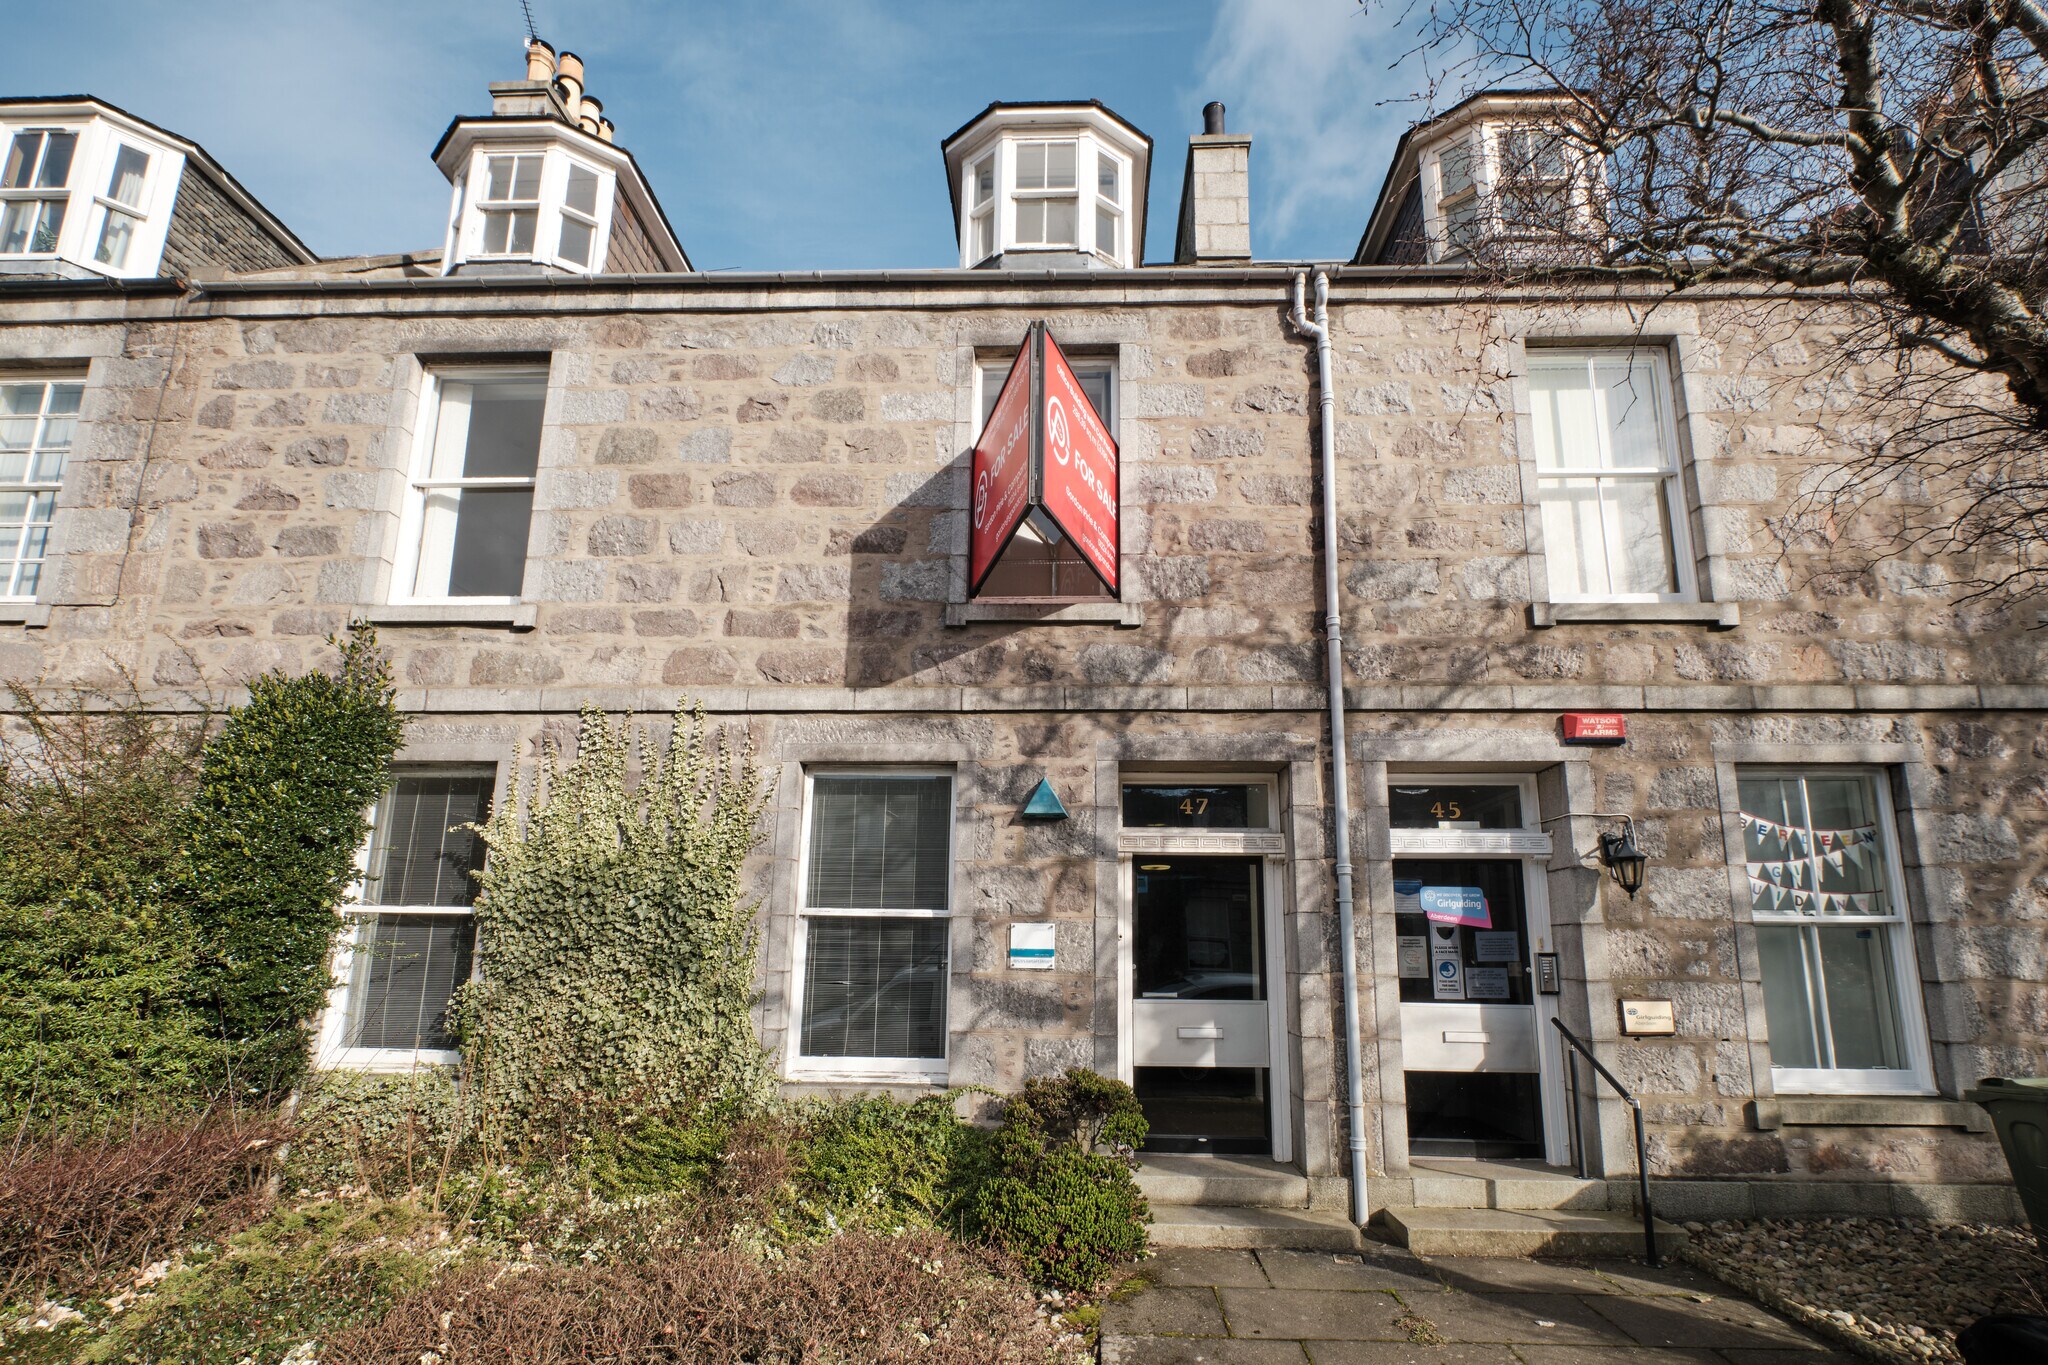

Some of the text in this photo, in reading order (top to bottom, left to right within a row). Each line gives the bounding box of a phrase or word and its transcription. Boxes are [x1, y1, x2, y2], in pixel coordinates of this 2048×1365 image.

[990, 446, 1006, 487] FOR
[1007, 403, 1029, 455] SALE
[1074, 449, 1095, 492] FOR
[1096, 479, 1117, 521] SALE
[1179, 798, 1209, 815] 47
[1430, 801, 1461, 819] 45
[1437, 899, 1482, 909] Girlguiding
[1430, 913, 1458, 922] Aberdeen
